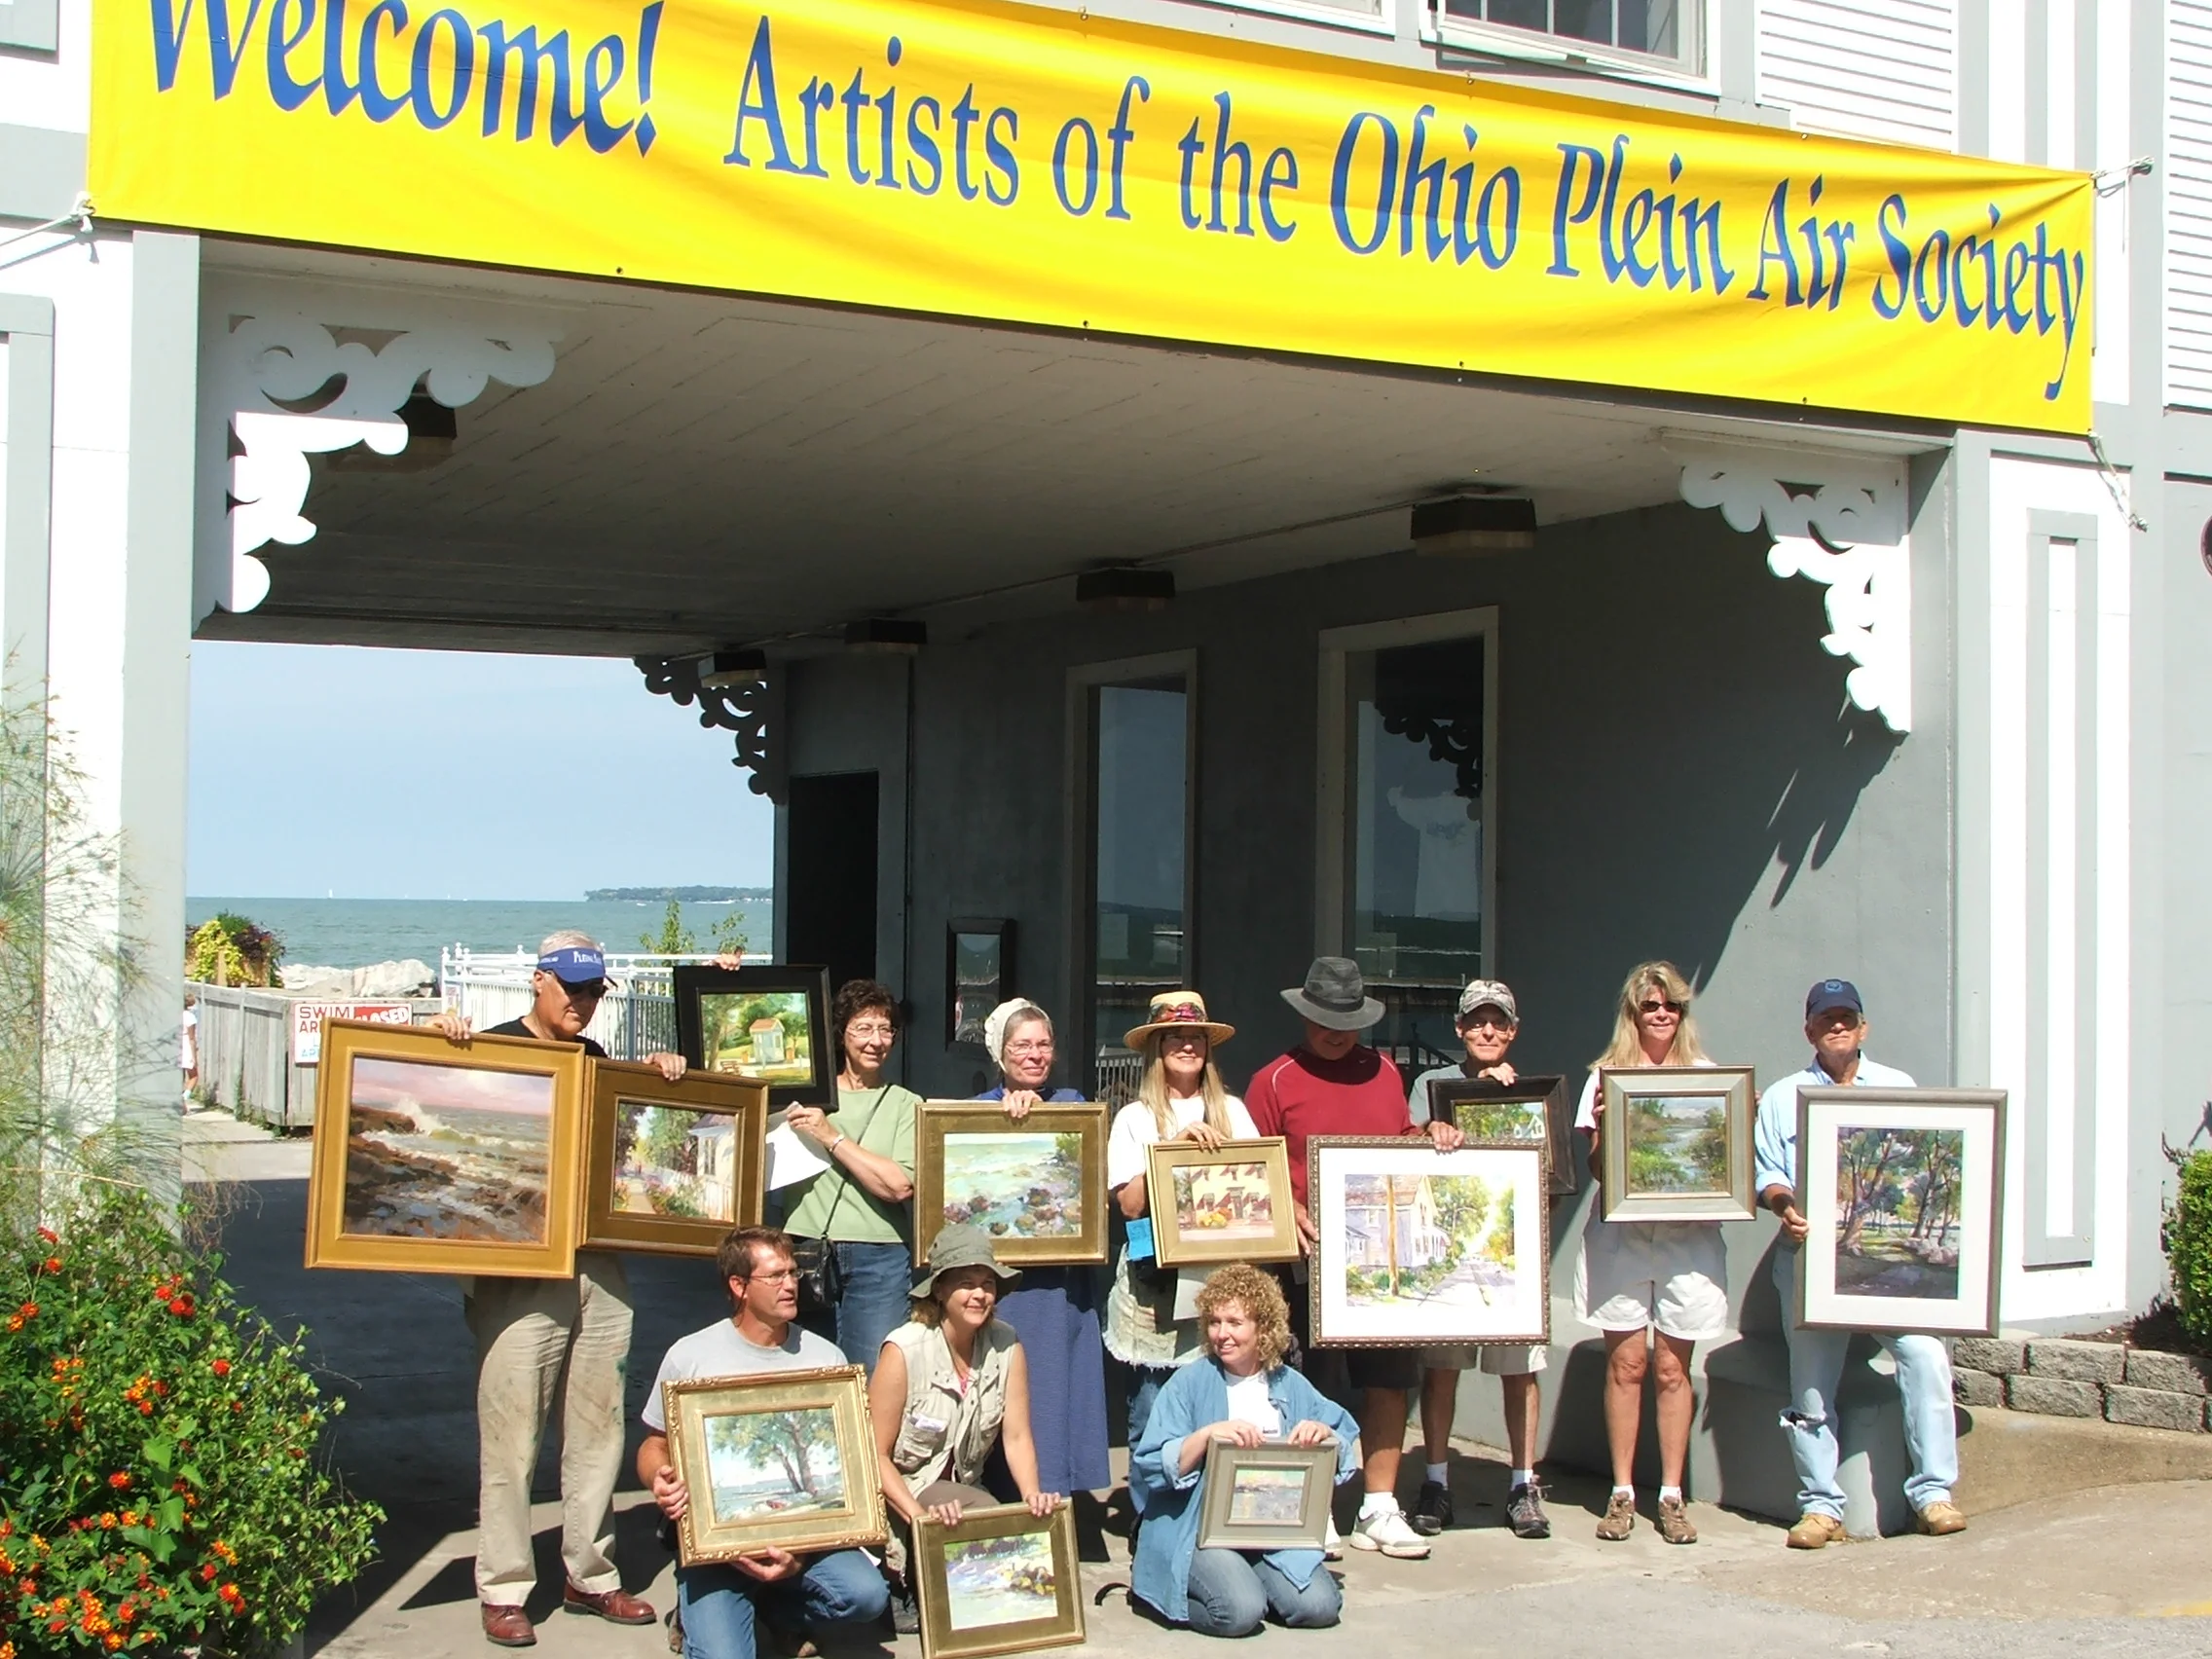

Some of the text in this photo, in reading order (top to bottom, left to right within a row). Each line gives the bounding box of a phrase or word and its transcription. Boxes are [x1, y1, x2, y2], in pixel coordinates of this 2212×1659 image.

[150, 0, 2085, 400] Welcome! Artists of the Ohio Plein Air Society
[299, 1006, 350, 1019] SWIM
[353, 1007, 409, 1024] OSED
[299, 1020, 319, 1033] AR
